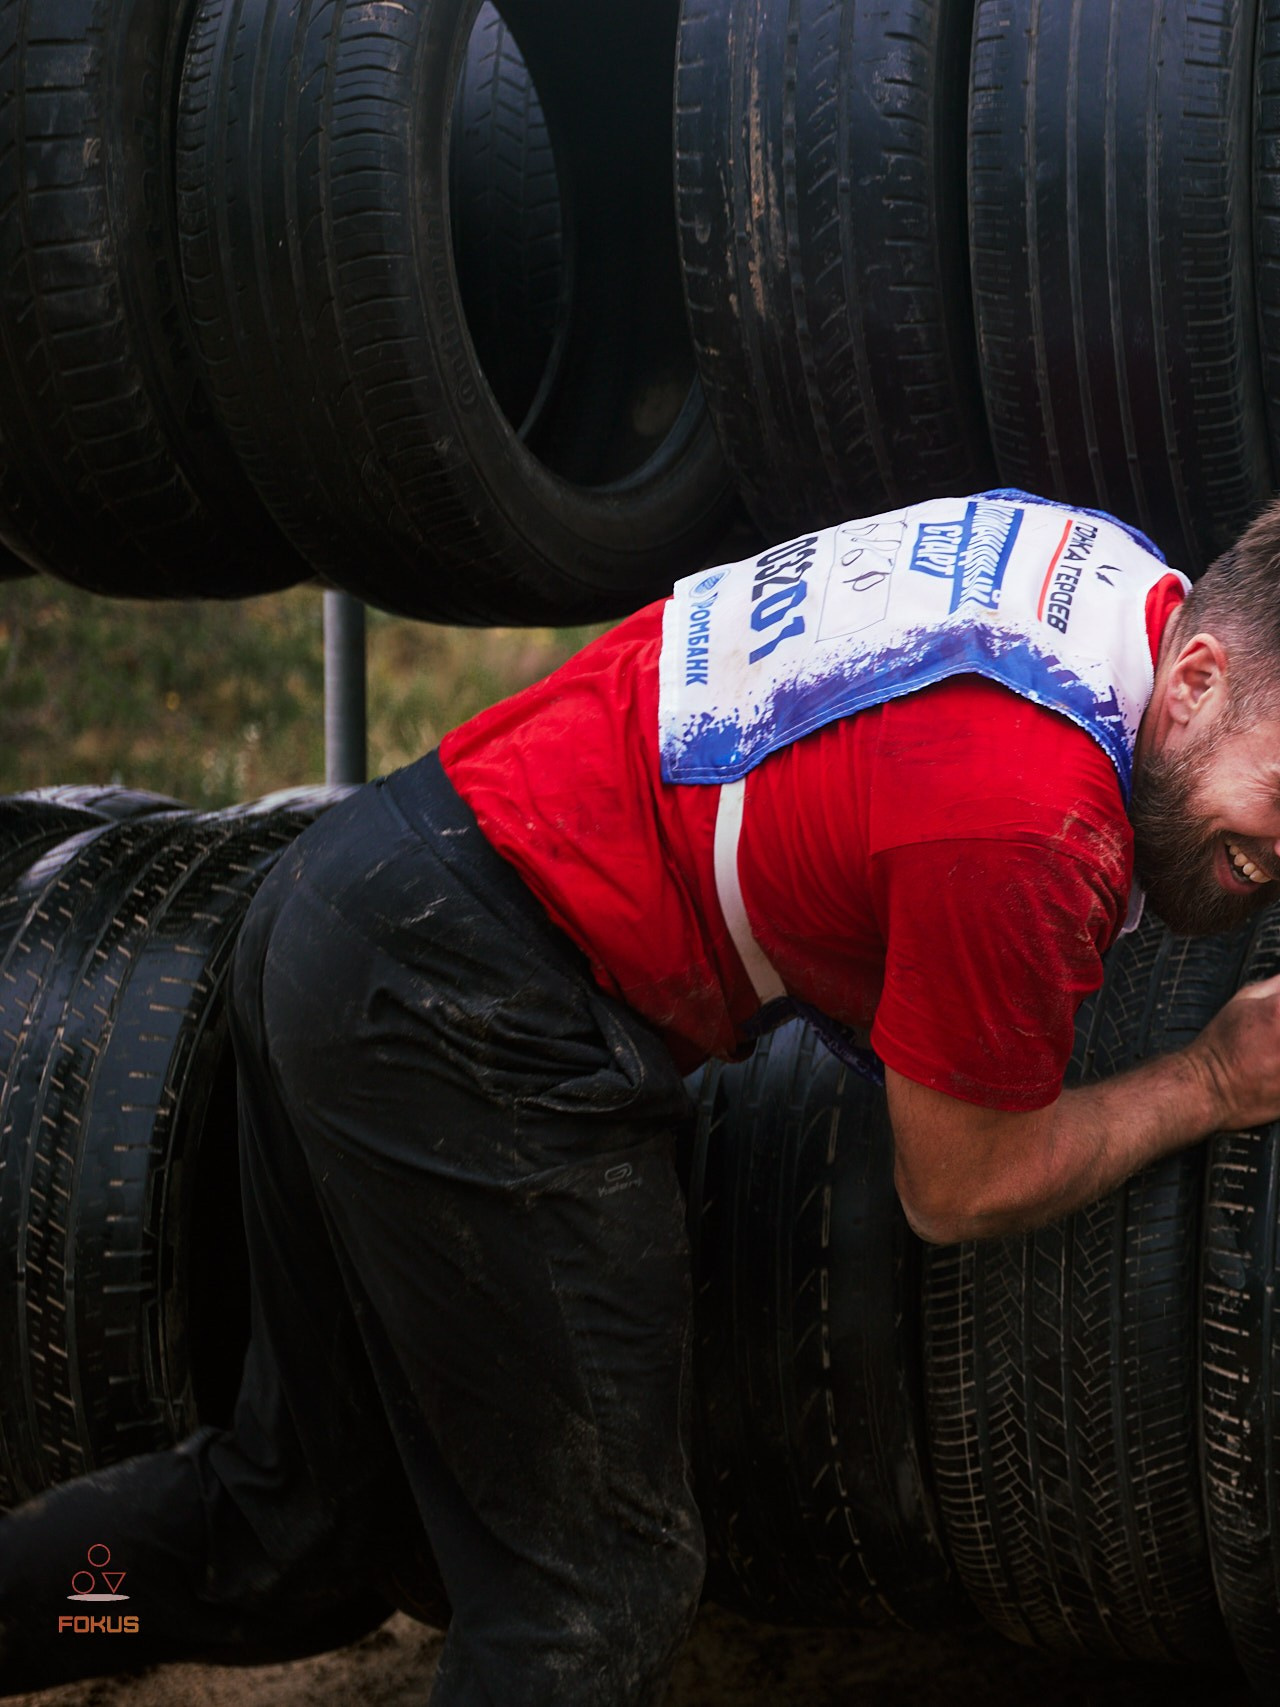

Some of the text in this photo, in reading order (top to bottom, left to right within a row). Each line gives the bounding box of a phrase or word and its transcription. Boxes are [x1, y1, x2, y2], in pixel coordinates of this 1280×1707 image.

[915, 524, 963, 576] СТАРТ
[1047, 521, 1098, 634] ГОНКА ГЕРОЕВ
